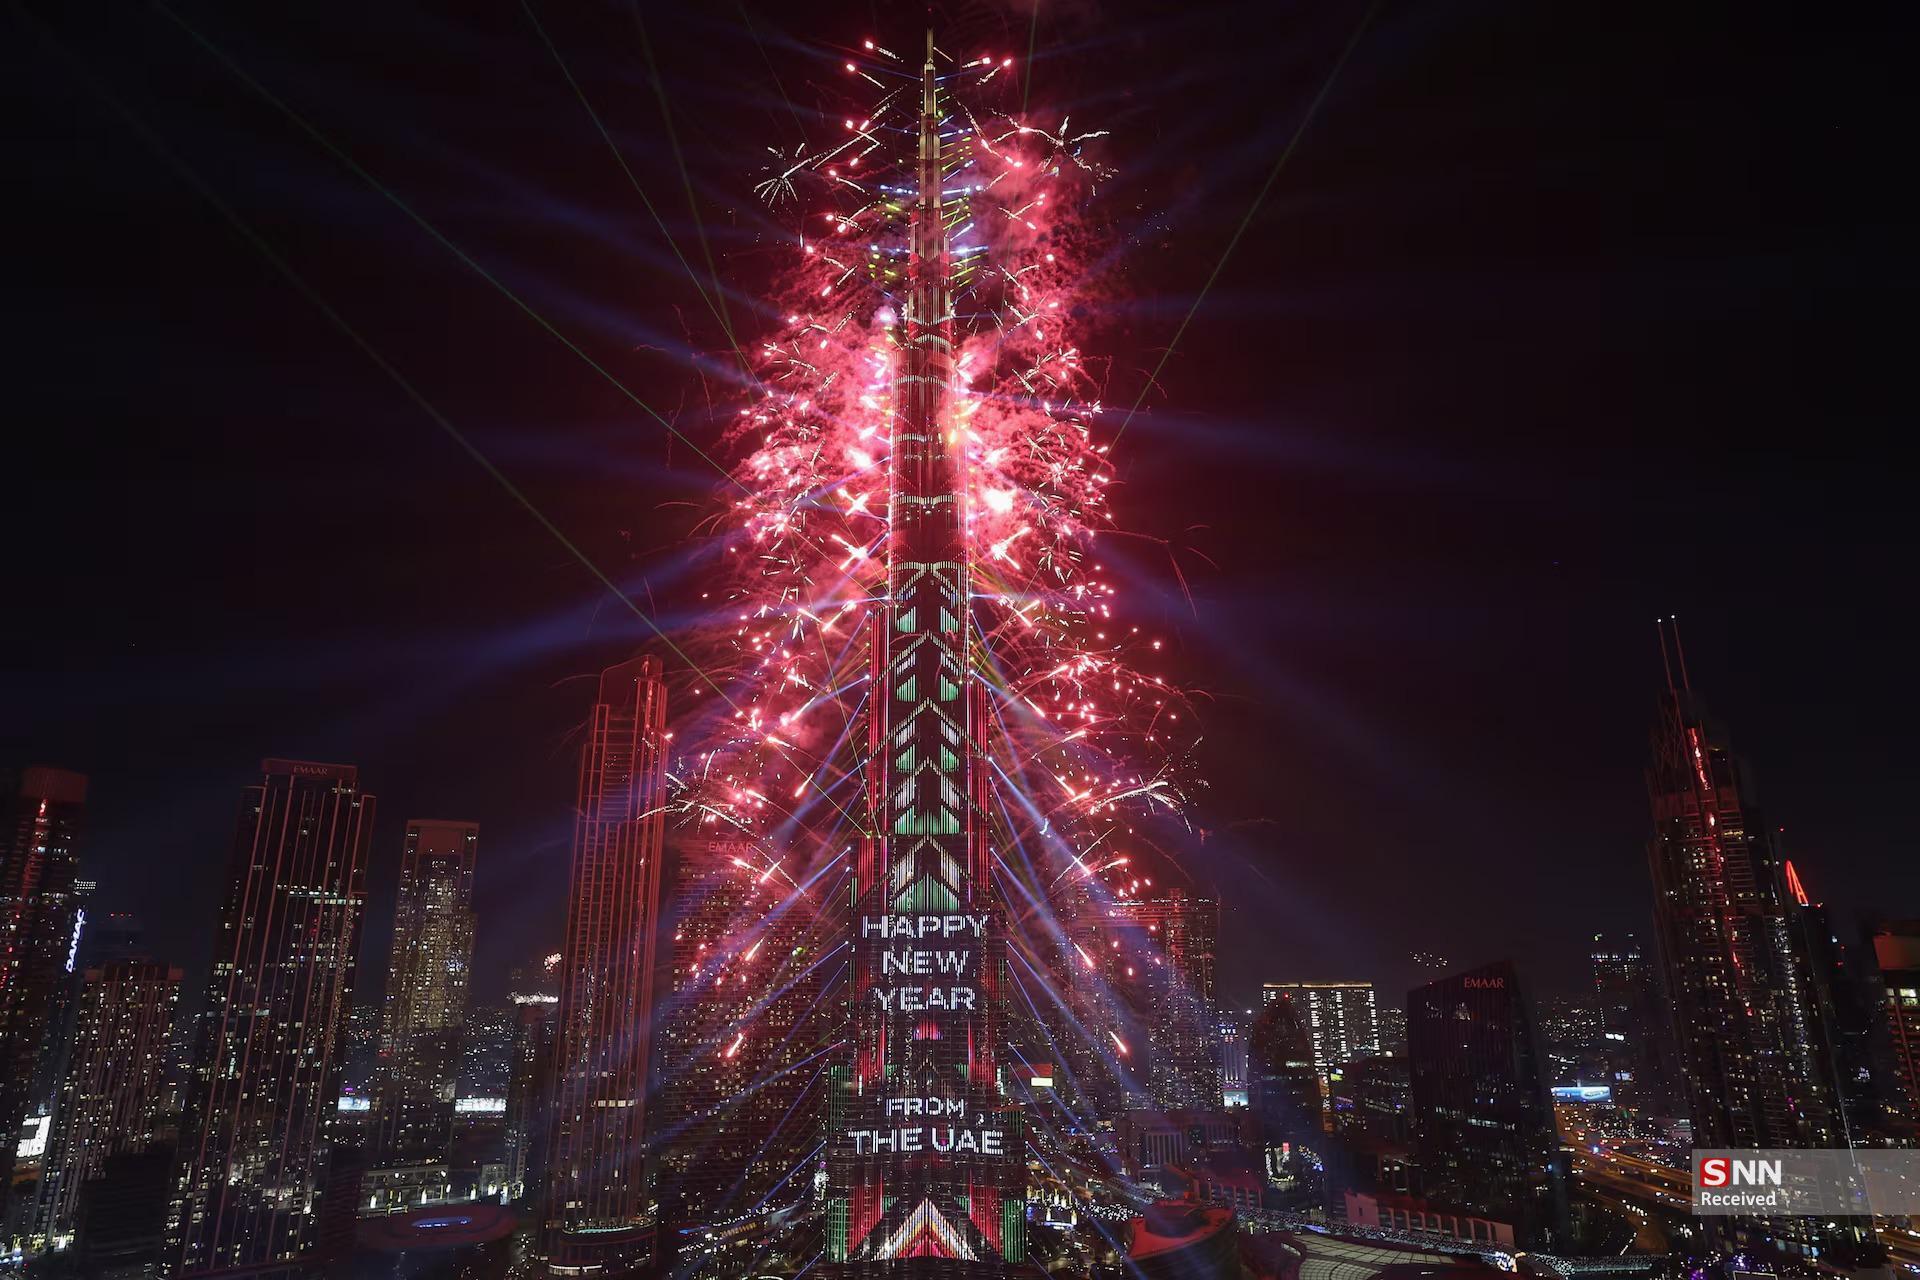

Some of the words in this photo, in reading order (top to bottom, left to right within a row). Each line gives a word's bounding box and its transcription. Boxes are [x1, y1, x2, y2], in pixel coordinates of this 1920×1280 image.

[708, 842, 756, 853] EMAAR
[862, 915, 990, 939] HAPPY
[65, 908, 84, 973] DAMAC
[882, 951, 969, 974] NEW
[1464, 977, 1505, 989] EMAAR
[872, 987, 976, 1011] YEAR
[885, 1097, 966, 1117] FROM
[847, 1128, 923, 1155] THE
[931, 1127, 1004, 1155] UAE
